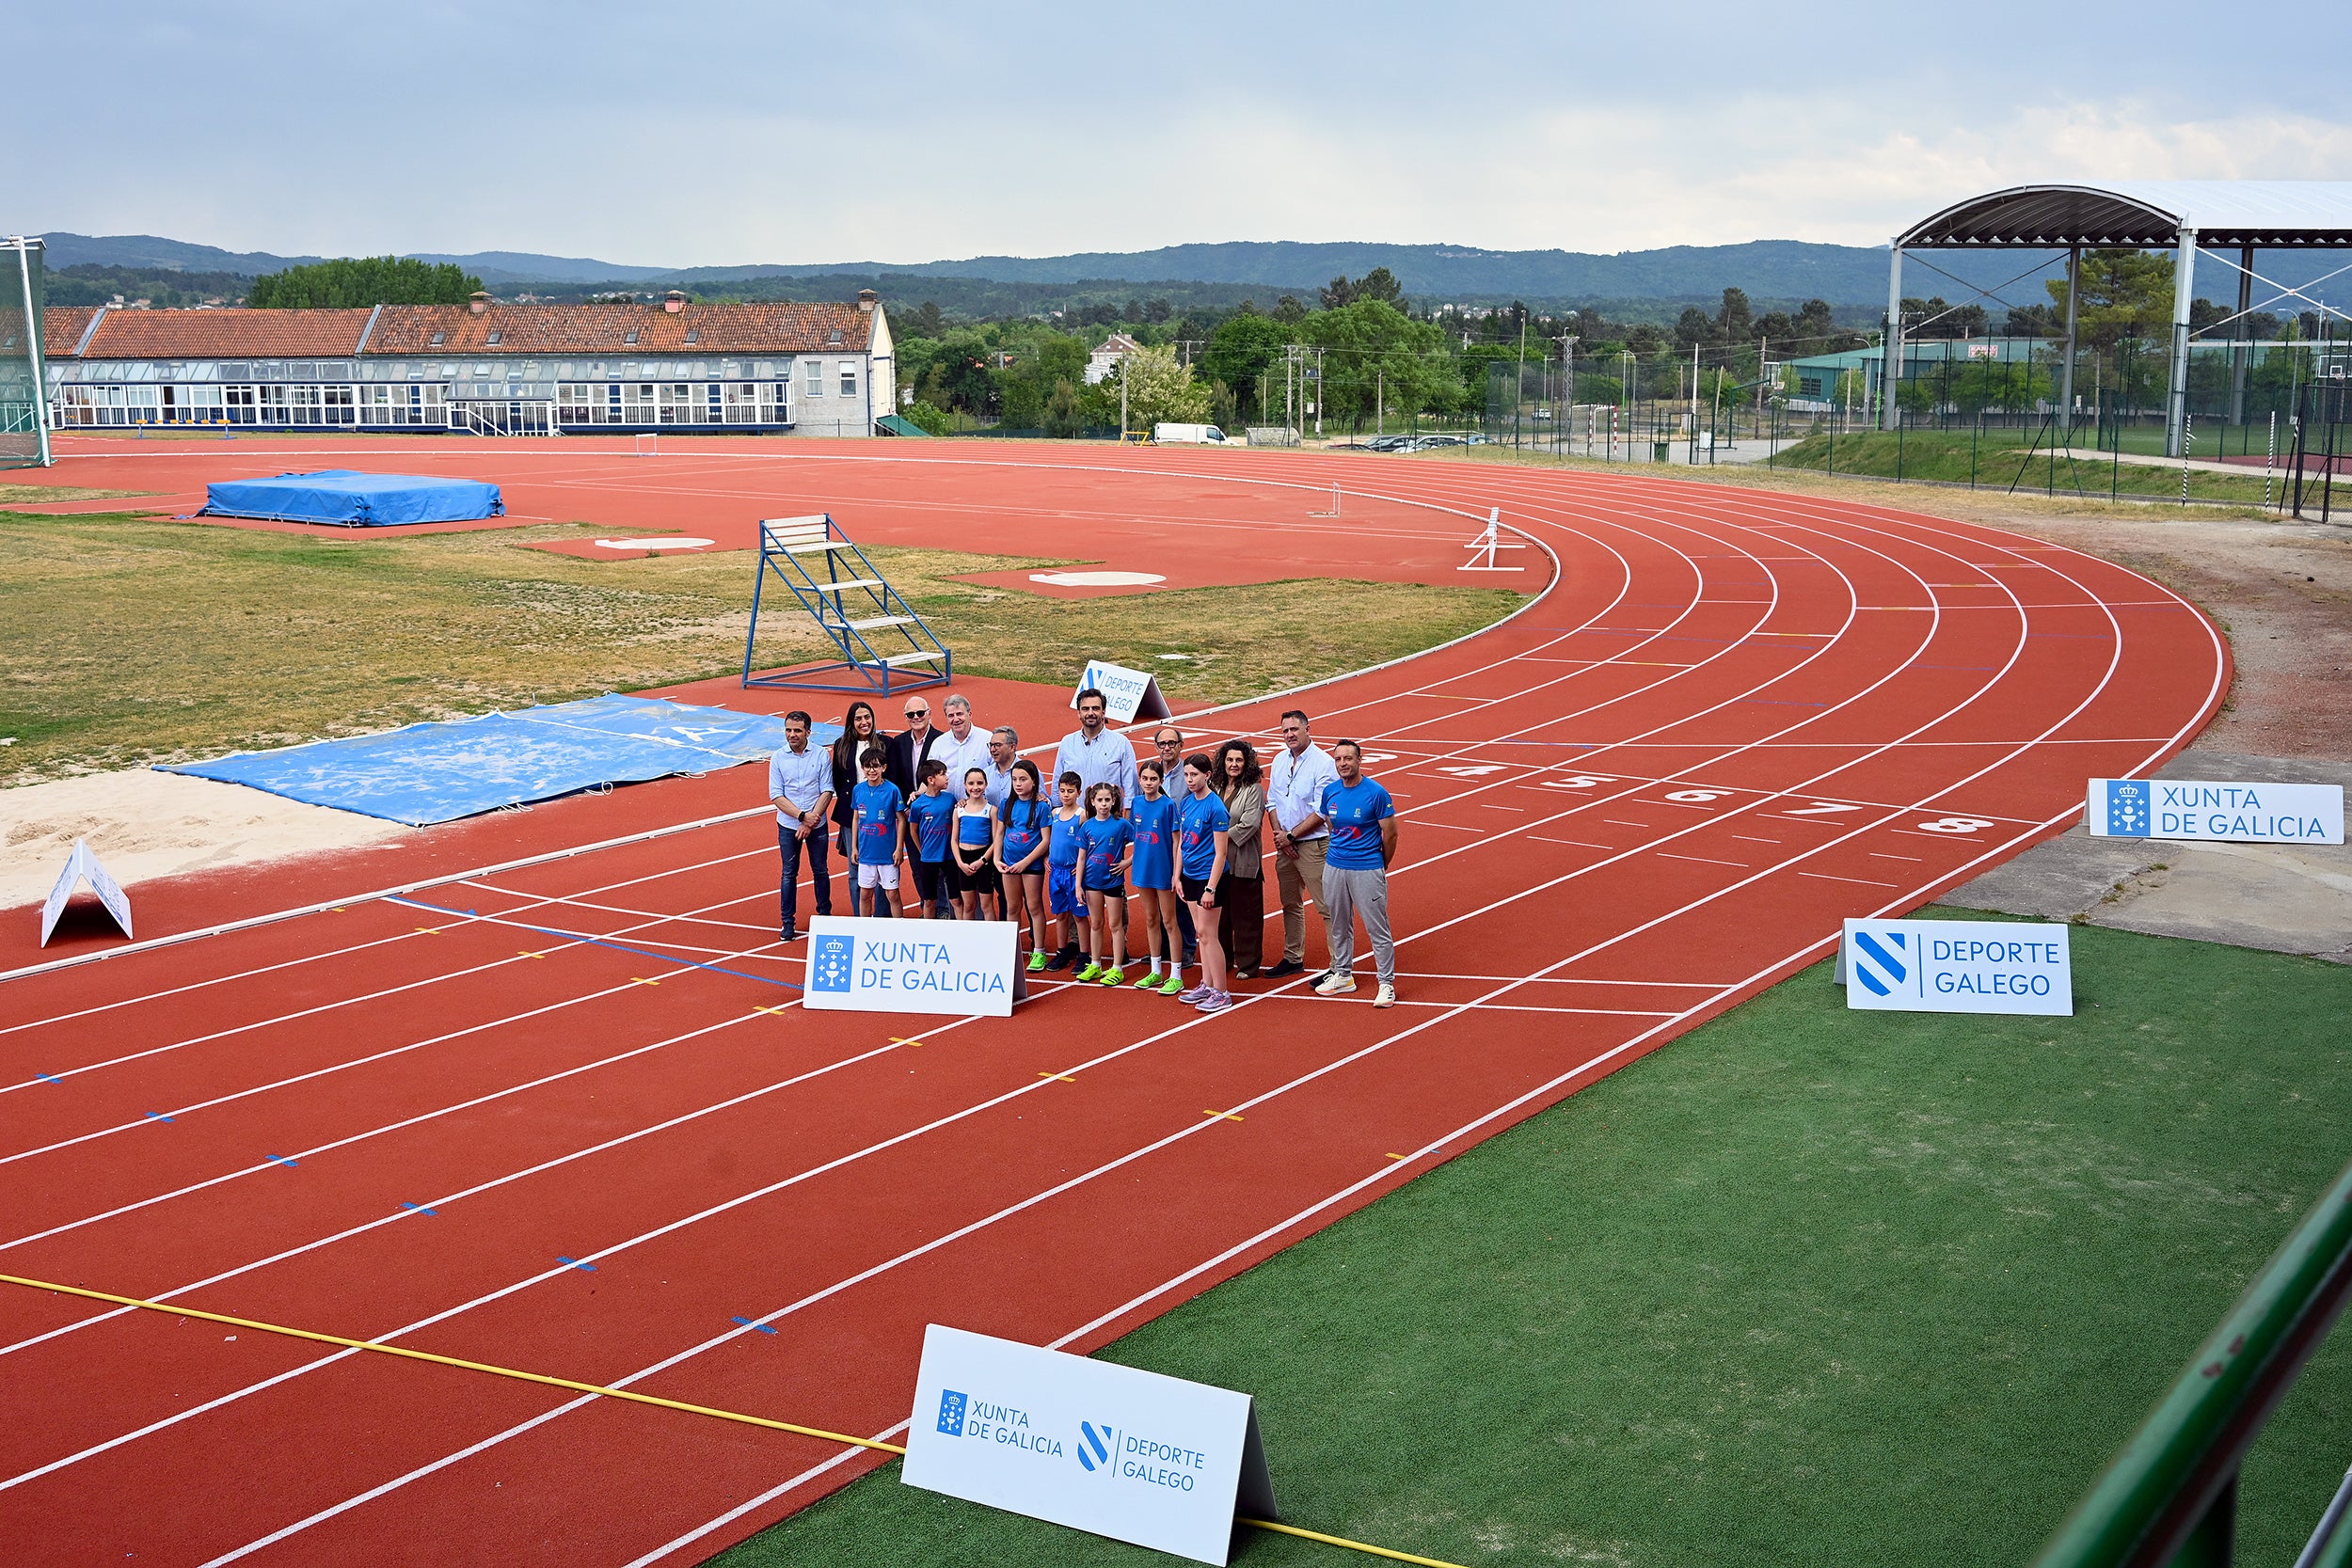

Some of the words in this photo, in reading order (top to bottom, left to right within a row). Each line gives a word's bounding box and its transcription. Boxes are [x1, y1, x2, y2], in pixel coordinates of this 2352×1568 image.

[1104, 675, 1144, 695] DEPORTE
[1435, 765, 1508, 777] 4
[1539, 775, 1618, 788] 5
[1664, 789, 1735, 801] 6
[2162, 786, 2261, 809] XUNTA
[1781, 801, 1864, 815] 7
[1916, 817, 1994, 833] 8
[2162, 813, 2197, 833] DE
[2208, 814, 2326, 838] GALICIA
[864, 942, 951, 964] XUNTA
[1933, 940, 2060, 964] DEPORTE
[861, 968, 893, 989] DE
[901, 969, 1006, 993] GALICIA
[1935, 972, 2050, 996] GALEGO
[972, 1400, 1029, 1428] XUNTA
[968, 1419, 989, 1440] DE
[994, 1427, 1063, 1458] GALICIA
[1125, 1436, 1205, 1469] DEPORTE
[1122, 1460, 1194, 1492] GALEGO
